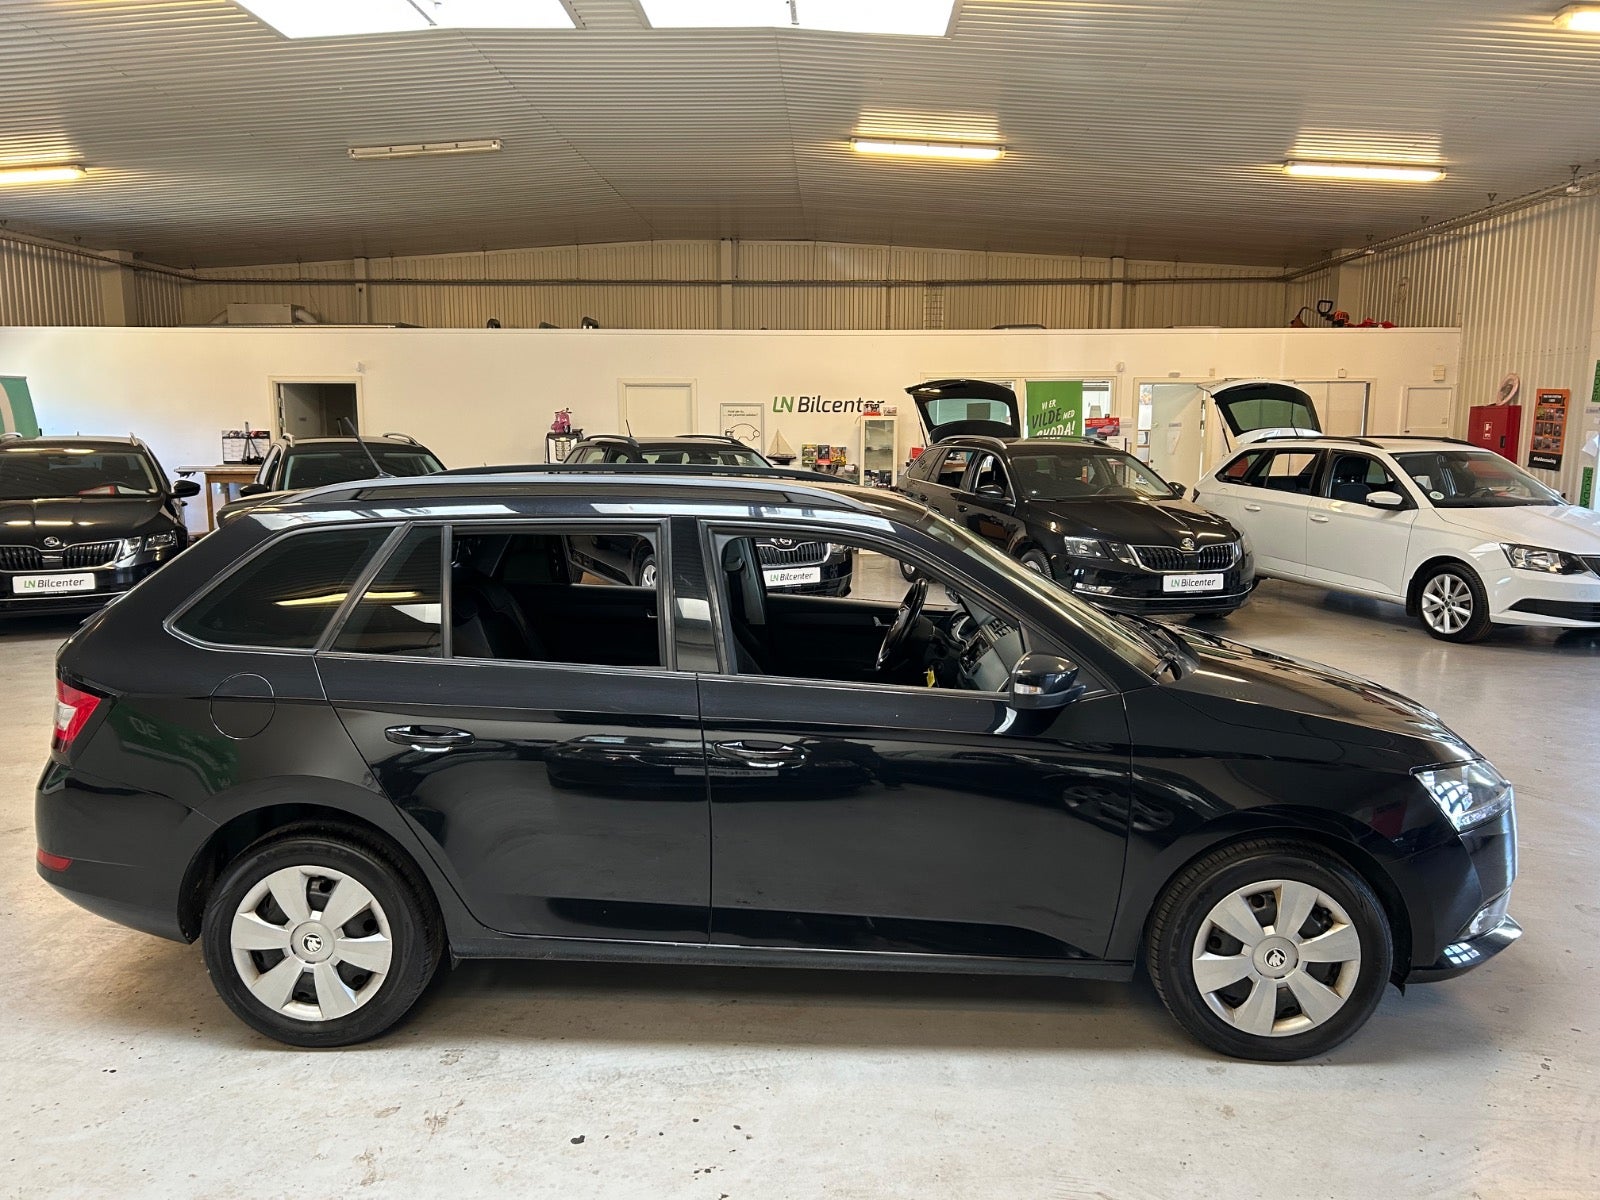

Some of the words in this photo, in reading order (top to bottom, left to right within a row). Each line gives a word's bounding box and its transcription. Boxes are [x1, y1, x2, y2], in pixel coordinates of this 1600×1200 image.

[772, 396, 795, 413] LN
[797, 395, 885, 413] Bilcent
[1048, 399, 1057, 408] ER
[1032, 407, 1062, 429] VILDE
[780, 572, 813, 581] Bilcenter
[24, 580, 36, 588] LN
[37, 579, 84, 588] Bilcenter
[1181, 578, 1216, 587] Bilcenter
